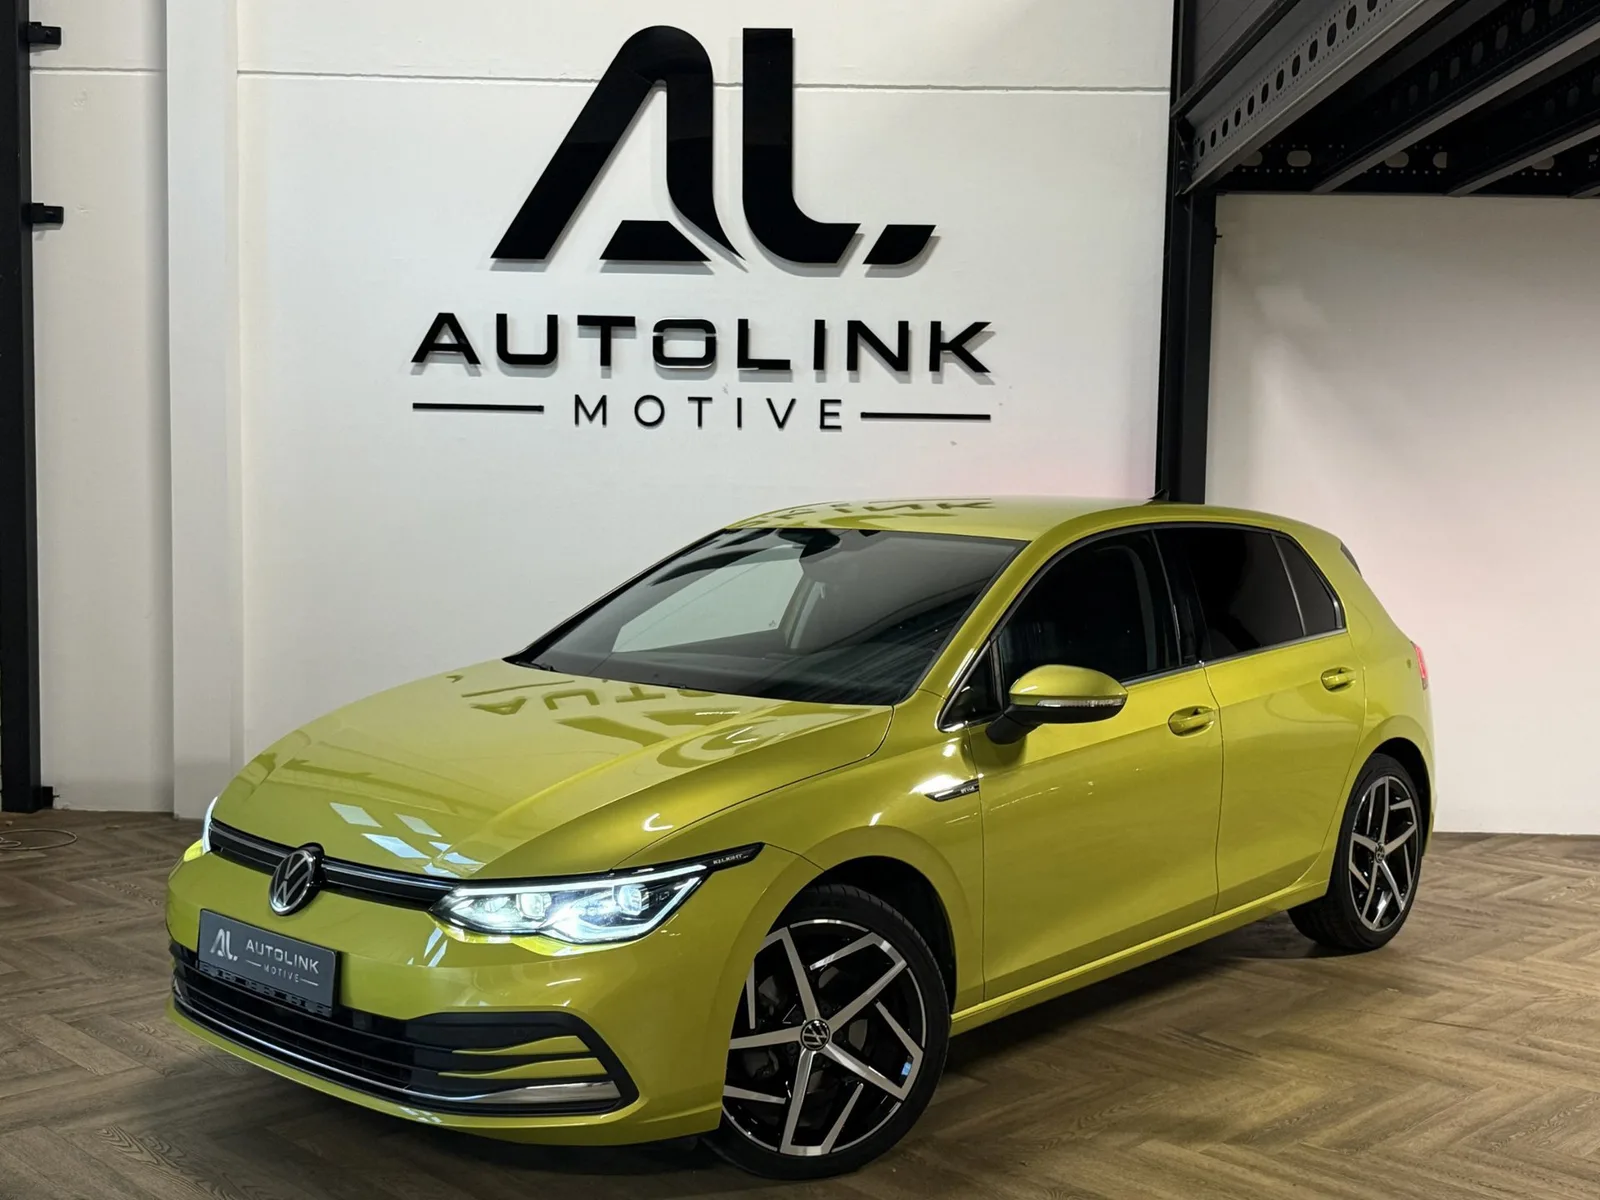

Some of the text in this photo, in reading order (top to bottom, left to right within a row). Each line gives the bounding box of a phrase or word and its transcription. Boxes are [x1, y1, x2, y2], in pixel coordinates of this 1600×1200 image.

[411, 312, 992, 374] AUTOLINK
[574, 394, 843, 430] MOTIVE
[245, 939, 320, 974] AUTOLINK
[263, 963, 300, 983] MOTIVE
